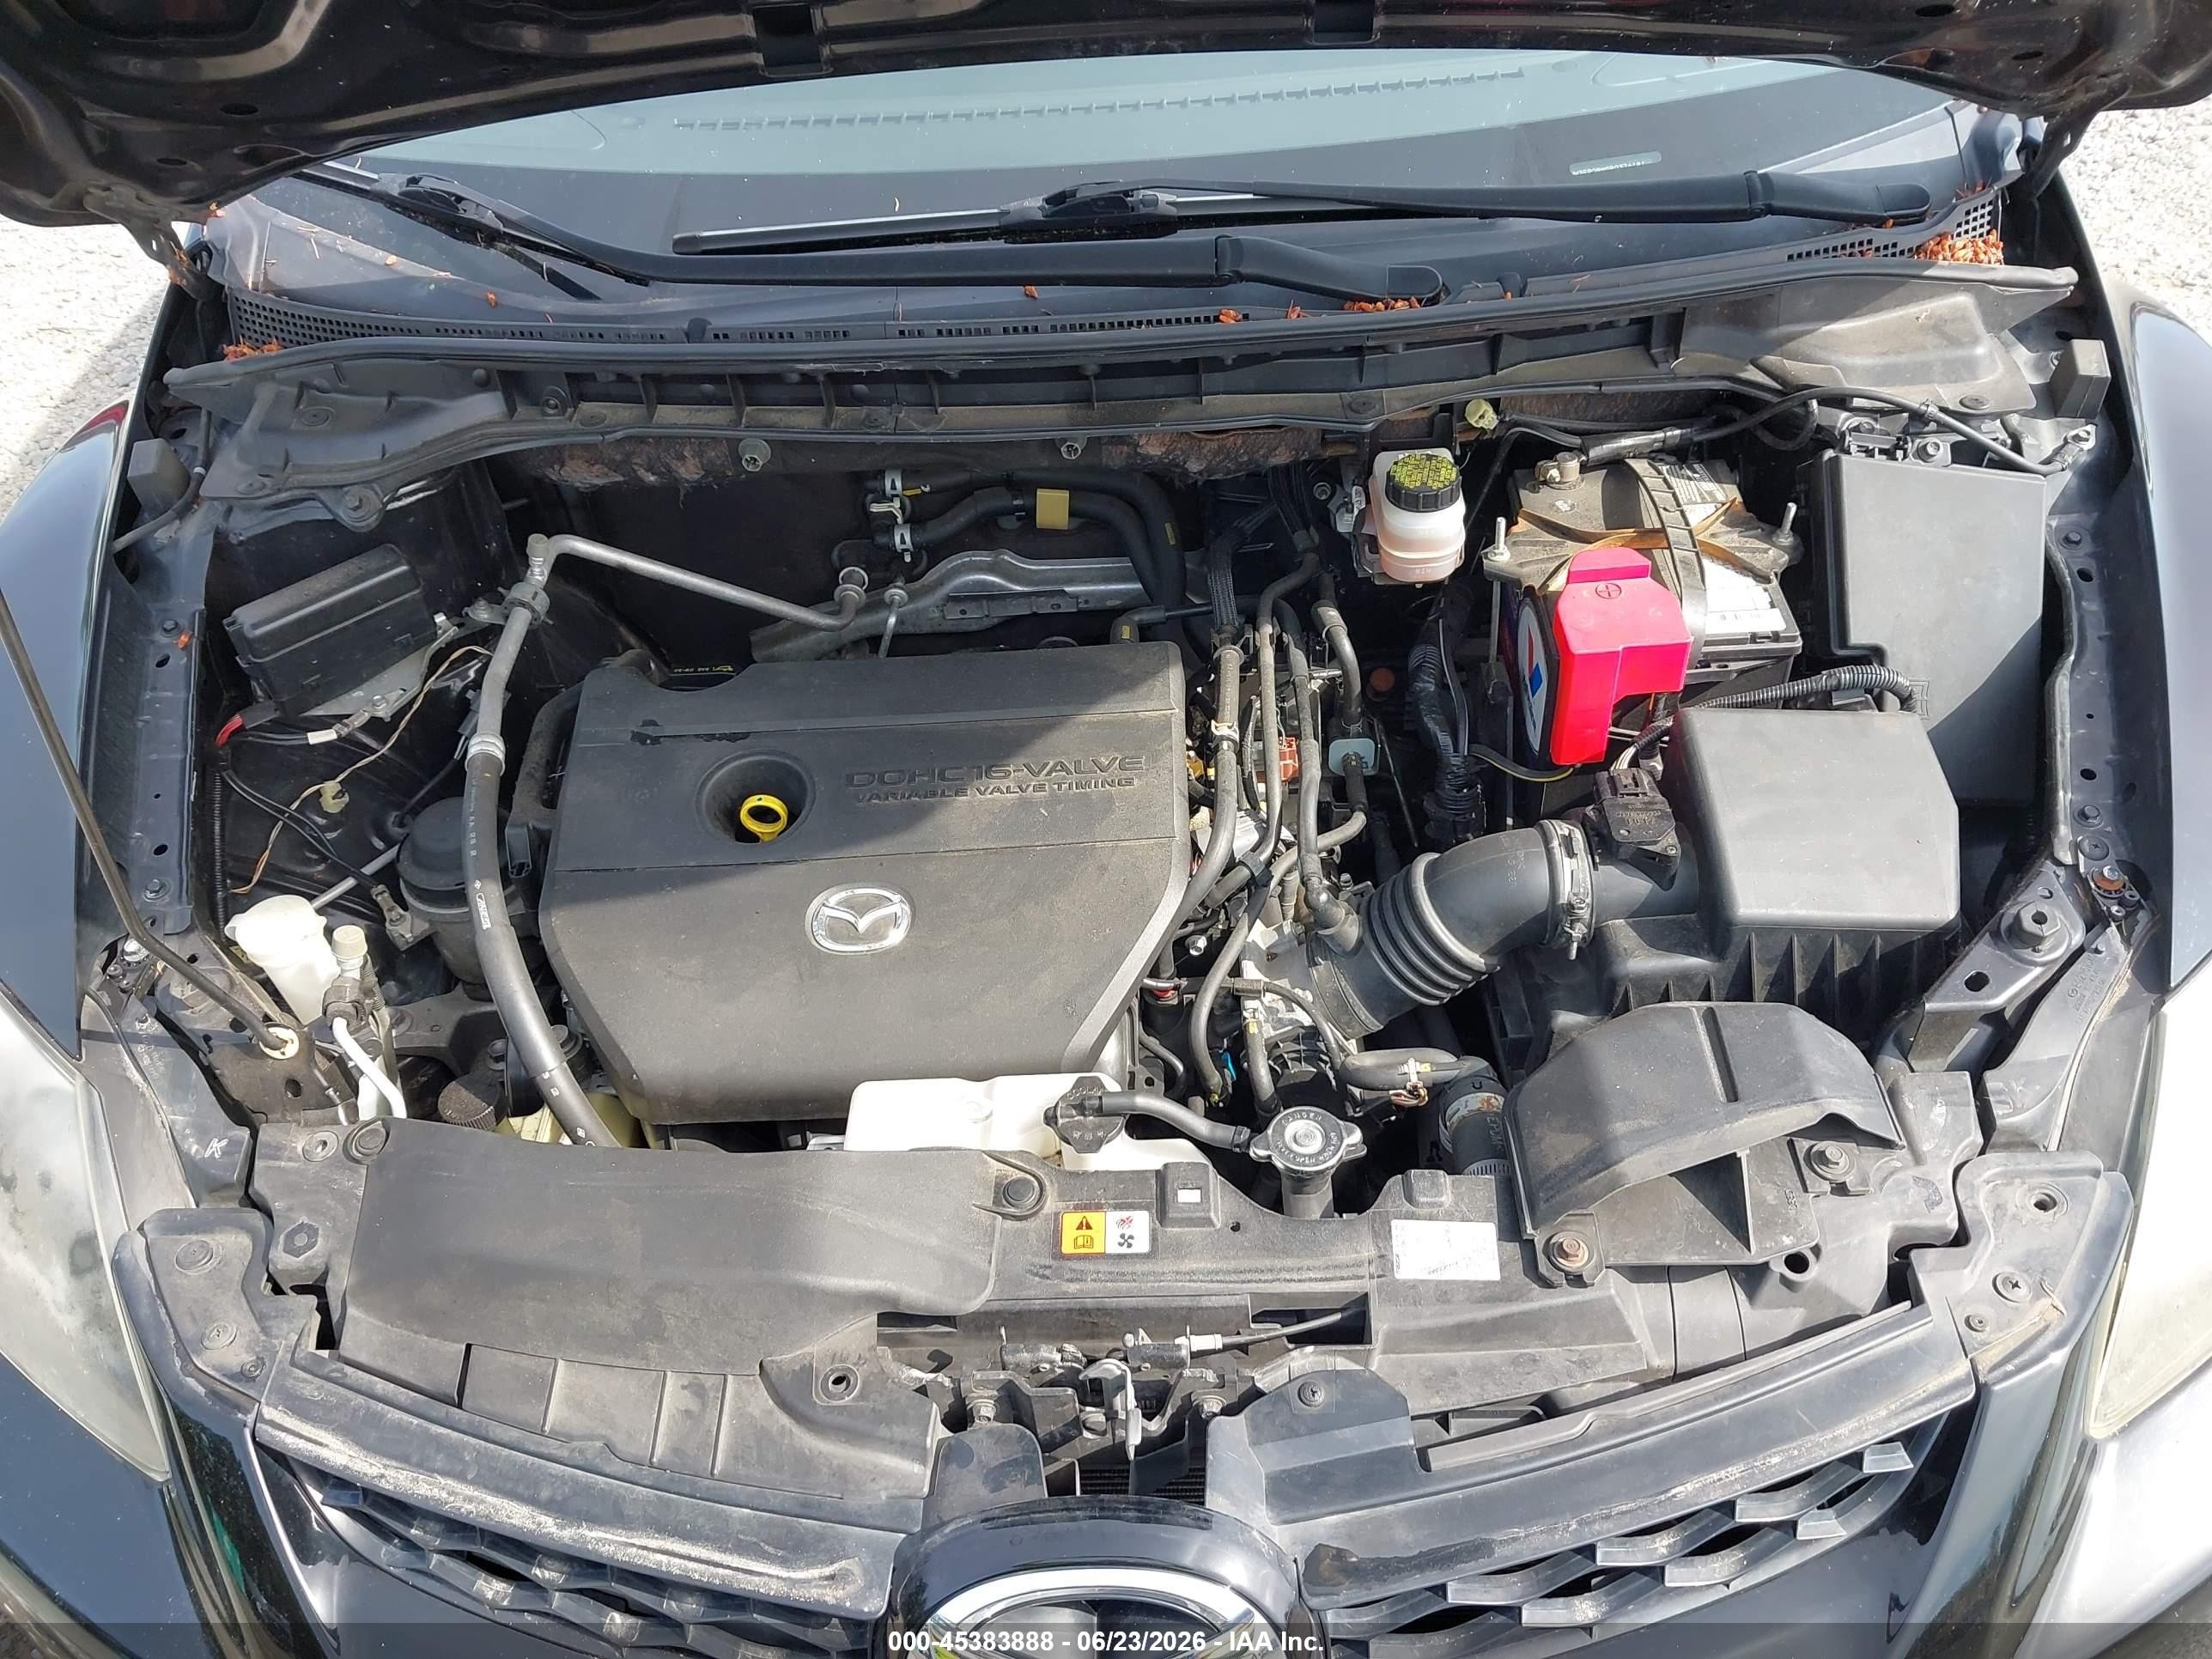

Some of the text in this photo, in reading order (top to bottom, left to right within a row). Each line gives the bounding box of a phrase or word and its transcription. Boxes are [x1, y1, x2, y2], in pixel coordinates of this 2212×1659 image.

[846, 755, 1146, 788] DOHC 16-VALVE
[858, 776, 1135, 805] VARIABLE VALVE TIMING
[1065, 1085, 1105, 1100] COOLAN
[1281, 1112, 1322, 1126] DANGER
[1295, 1154, 1316, 1164] OPEN
